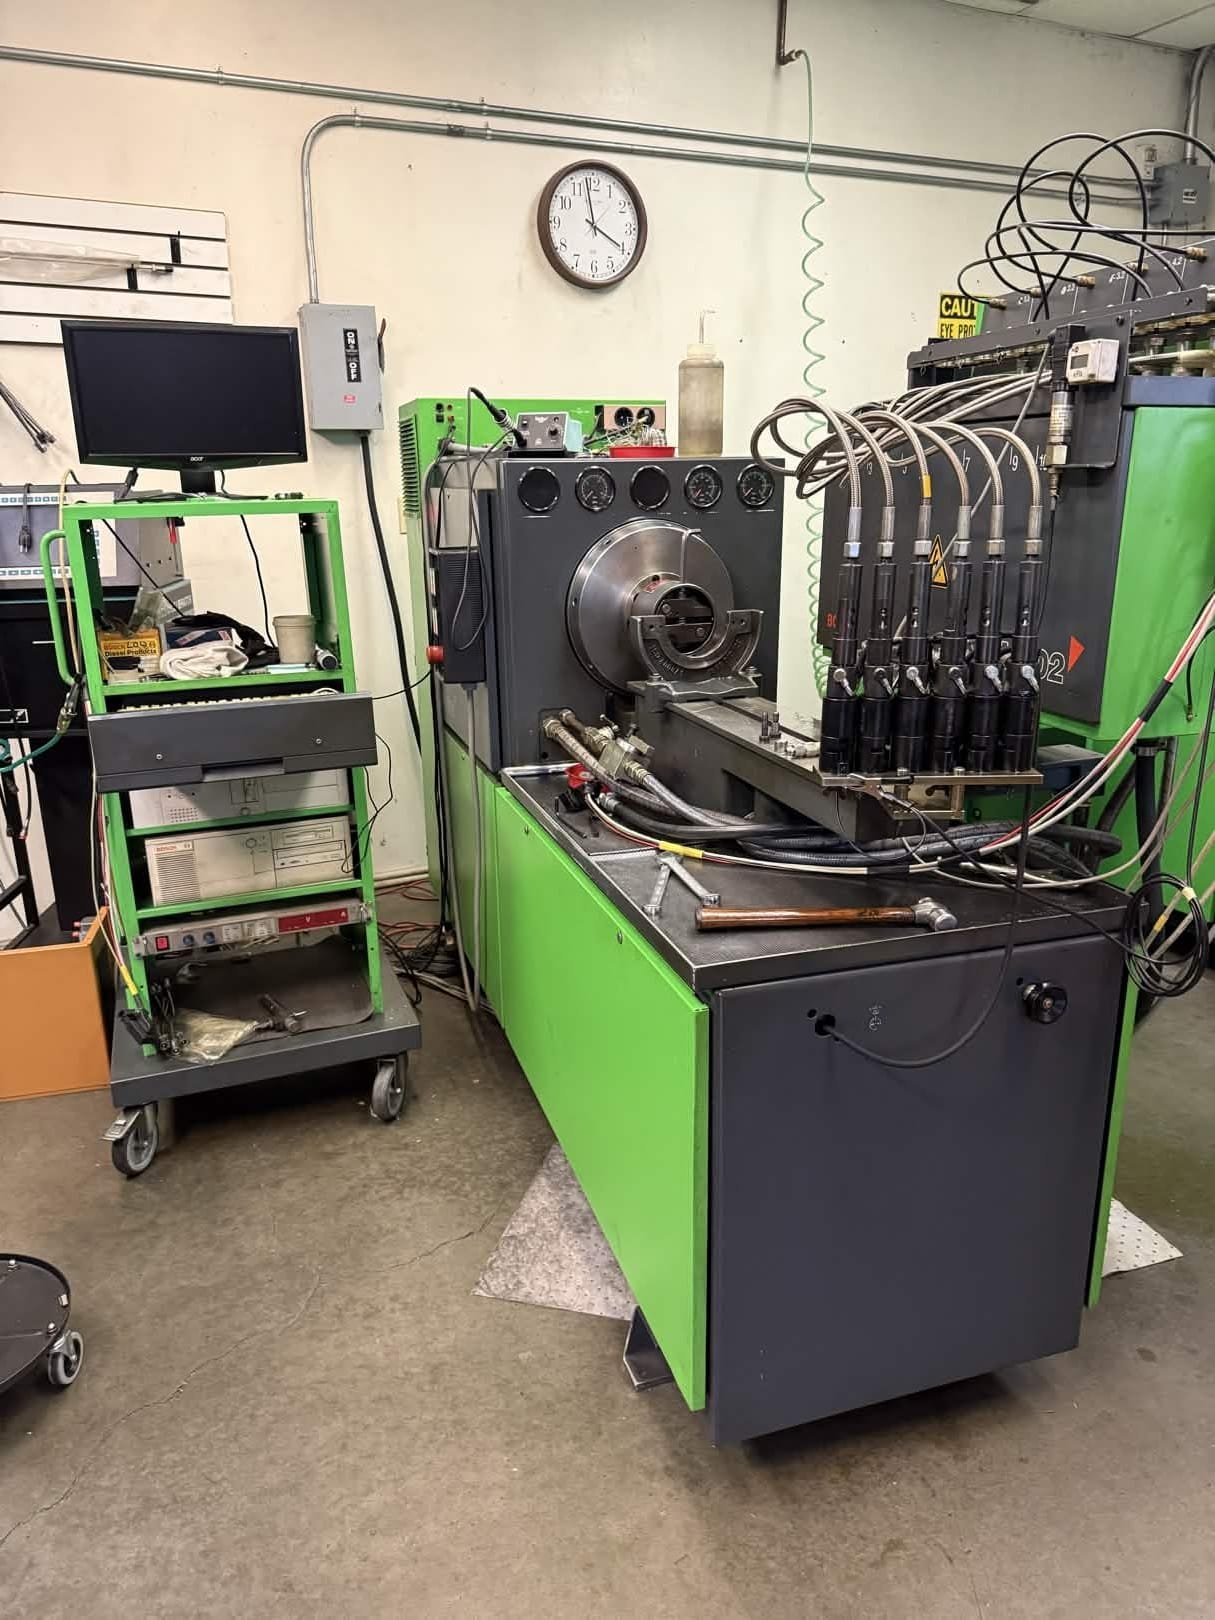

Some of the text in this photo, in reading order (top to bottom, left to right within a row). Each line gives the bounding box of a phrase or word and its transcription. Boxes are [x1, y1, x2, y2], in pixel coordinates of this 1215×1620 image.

[571, 181, 582, 196] 11
[607, 183, 612, 199] 1
[560, 195, 572, 210] 10
[619, 200, 626, 214] 2
[553, 215, 561, 229] 9
[625, 223, 632, 236] 3
[560, 238, 567, 252] 8
[573, 254, 580, 271] 7
[591, 260, 598, 274] 6
[606, 255, 614, 269] 5
[347, 331, 356, 345] ON
[941, 323, 954, 338] EYE
[349, 362, 357, 381] OFF
[964, 456, 971, 473] 7
[1011, 455, 1019, 472] 9
